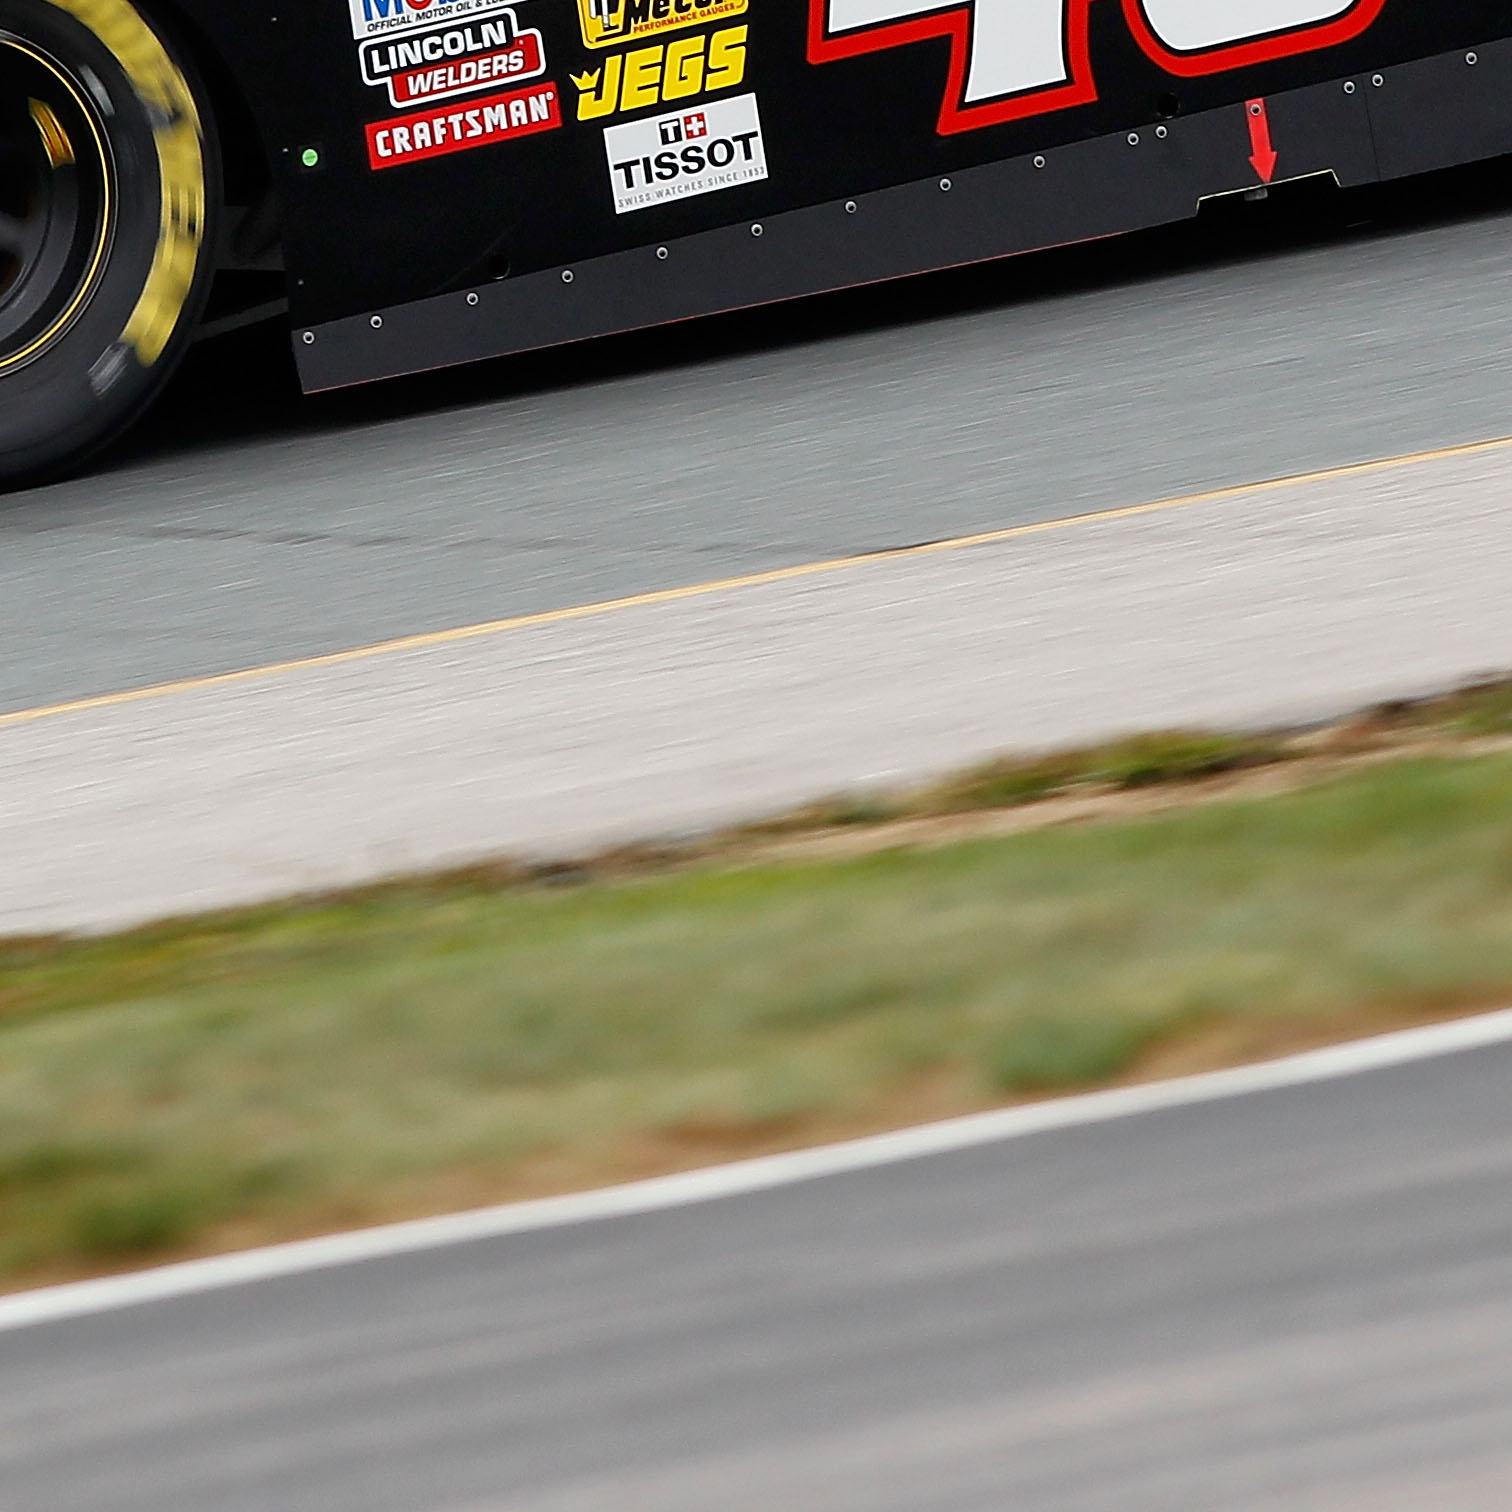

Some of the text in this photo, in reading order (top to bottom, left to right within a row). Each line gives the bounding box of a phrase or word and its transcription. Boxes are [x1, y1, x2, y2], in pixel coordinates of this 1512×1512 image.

[366, 14, 413, 33] OFFICIAL
[415, 6, 454, 23] MOTOR
[456, 0, 473, 13] OIL
[475, 0, 484, 8] &
[633, 1, 736, 34] PERFORMANCE GAUGES
[370, 20, 507, 74] LINCOLN
[407, 50, 524, 97] WELDERS
[576, 24, 749, 122] JEGS
[375, 92, 549, 158] CRAFTSMAN
[613, 131, 759, 190] TISSOT
[618, 195, 651, 208] SWISS
[654, 181, 704, 202] WATCHES
[707, 173, 738, 188] SINCE
